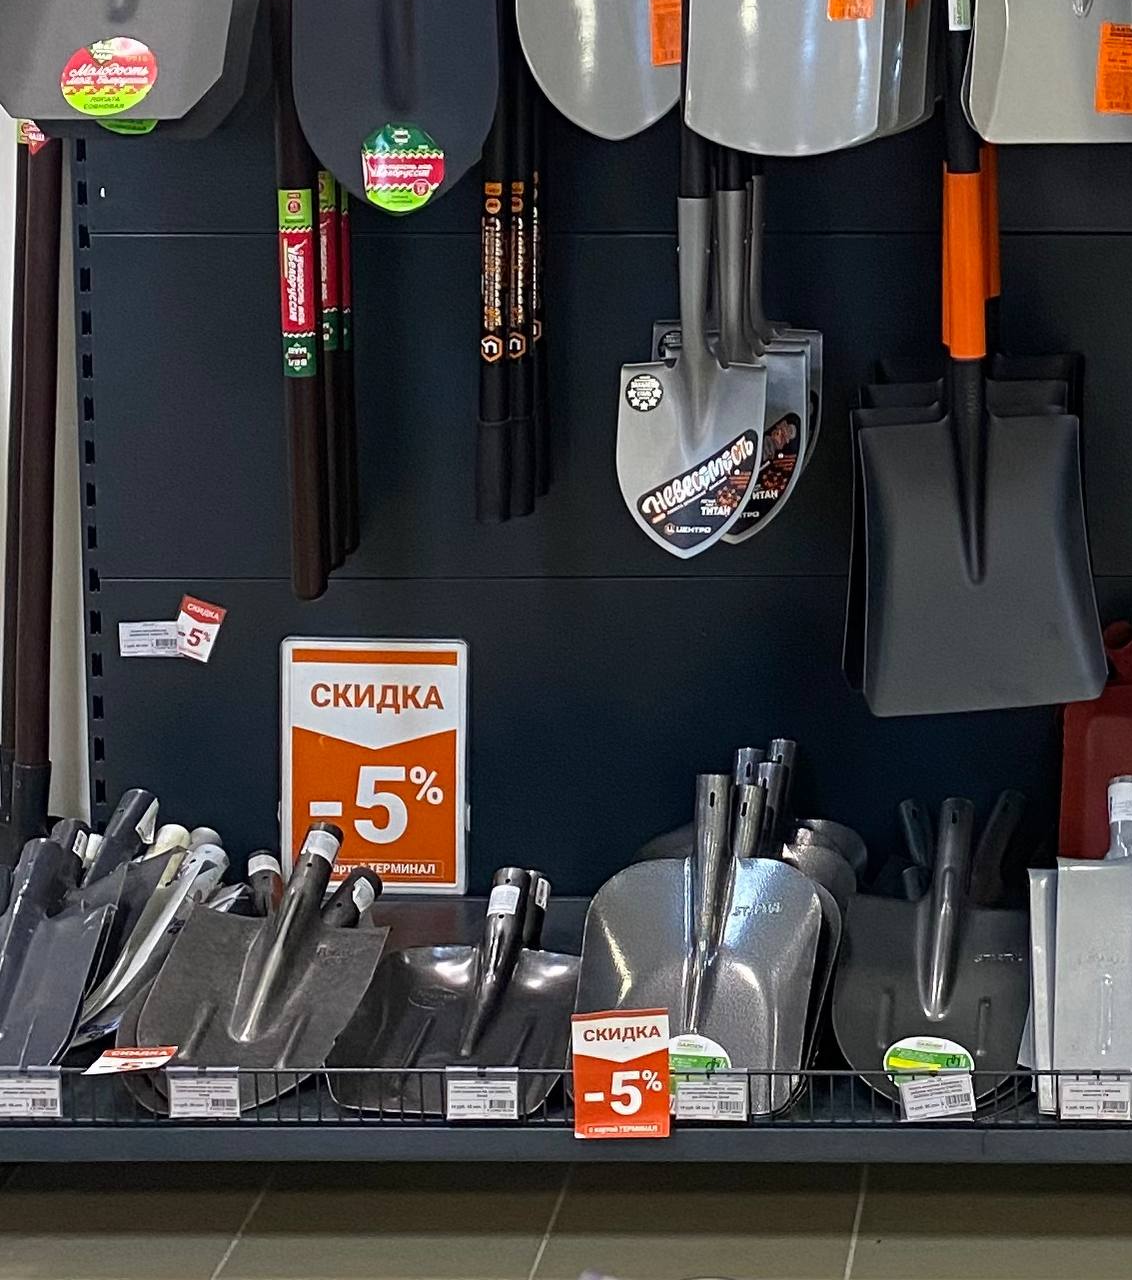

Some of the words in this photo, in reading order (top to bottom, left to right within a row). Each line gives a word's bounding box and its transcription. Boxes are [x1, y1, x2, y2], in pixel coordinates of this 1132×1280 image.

[642, 436, 754, 514] Невесомость
[753, 490, 778, 500] ИТАН
[701, 506, 731, 517] ТИТАН
[676, 526, 711, 535] ЦЕНТРО
[187, 602, 221, 622] СКИДКА
[310, 683, 444, 714] СКИДКА
[309, 766, 444, 844] -5%
[367, 863, 436, 875] ТЕРМИНАЛ
[584, 1023, 662, 1045] СКИДКА
[584, 1070, 663, 1116] -5%
